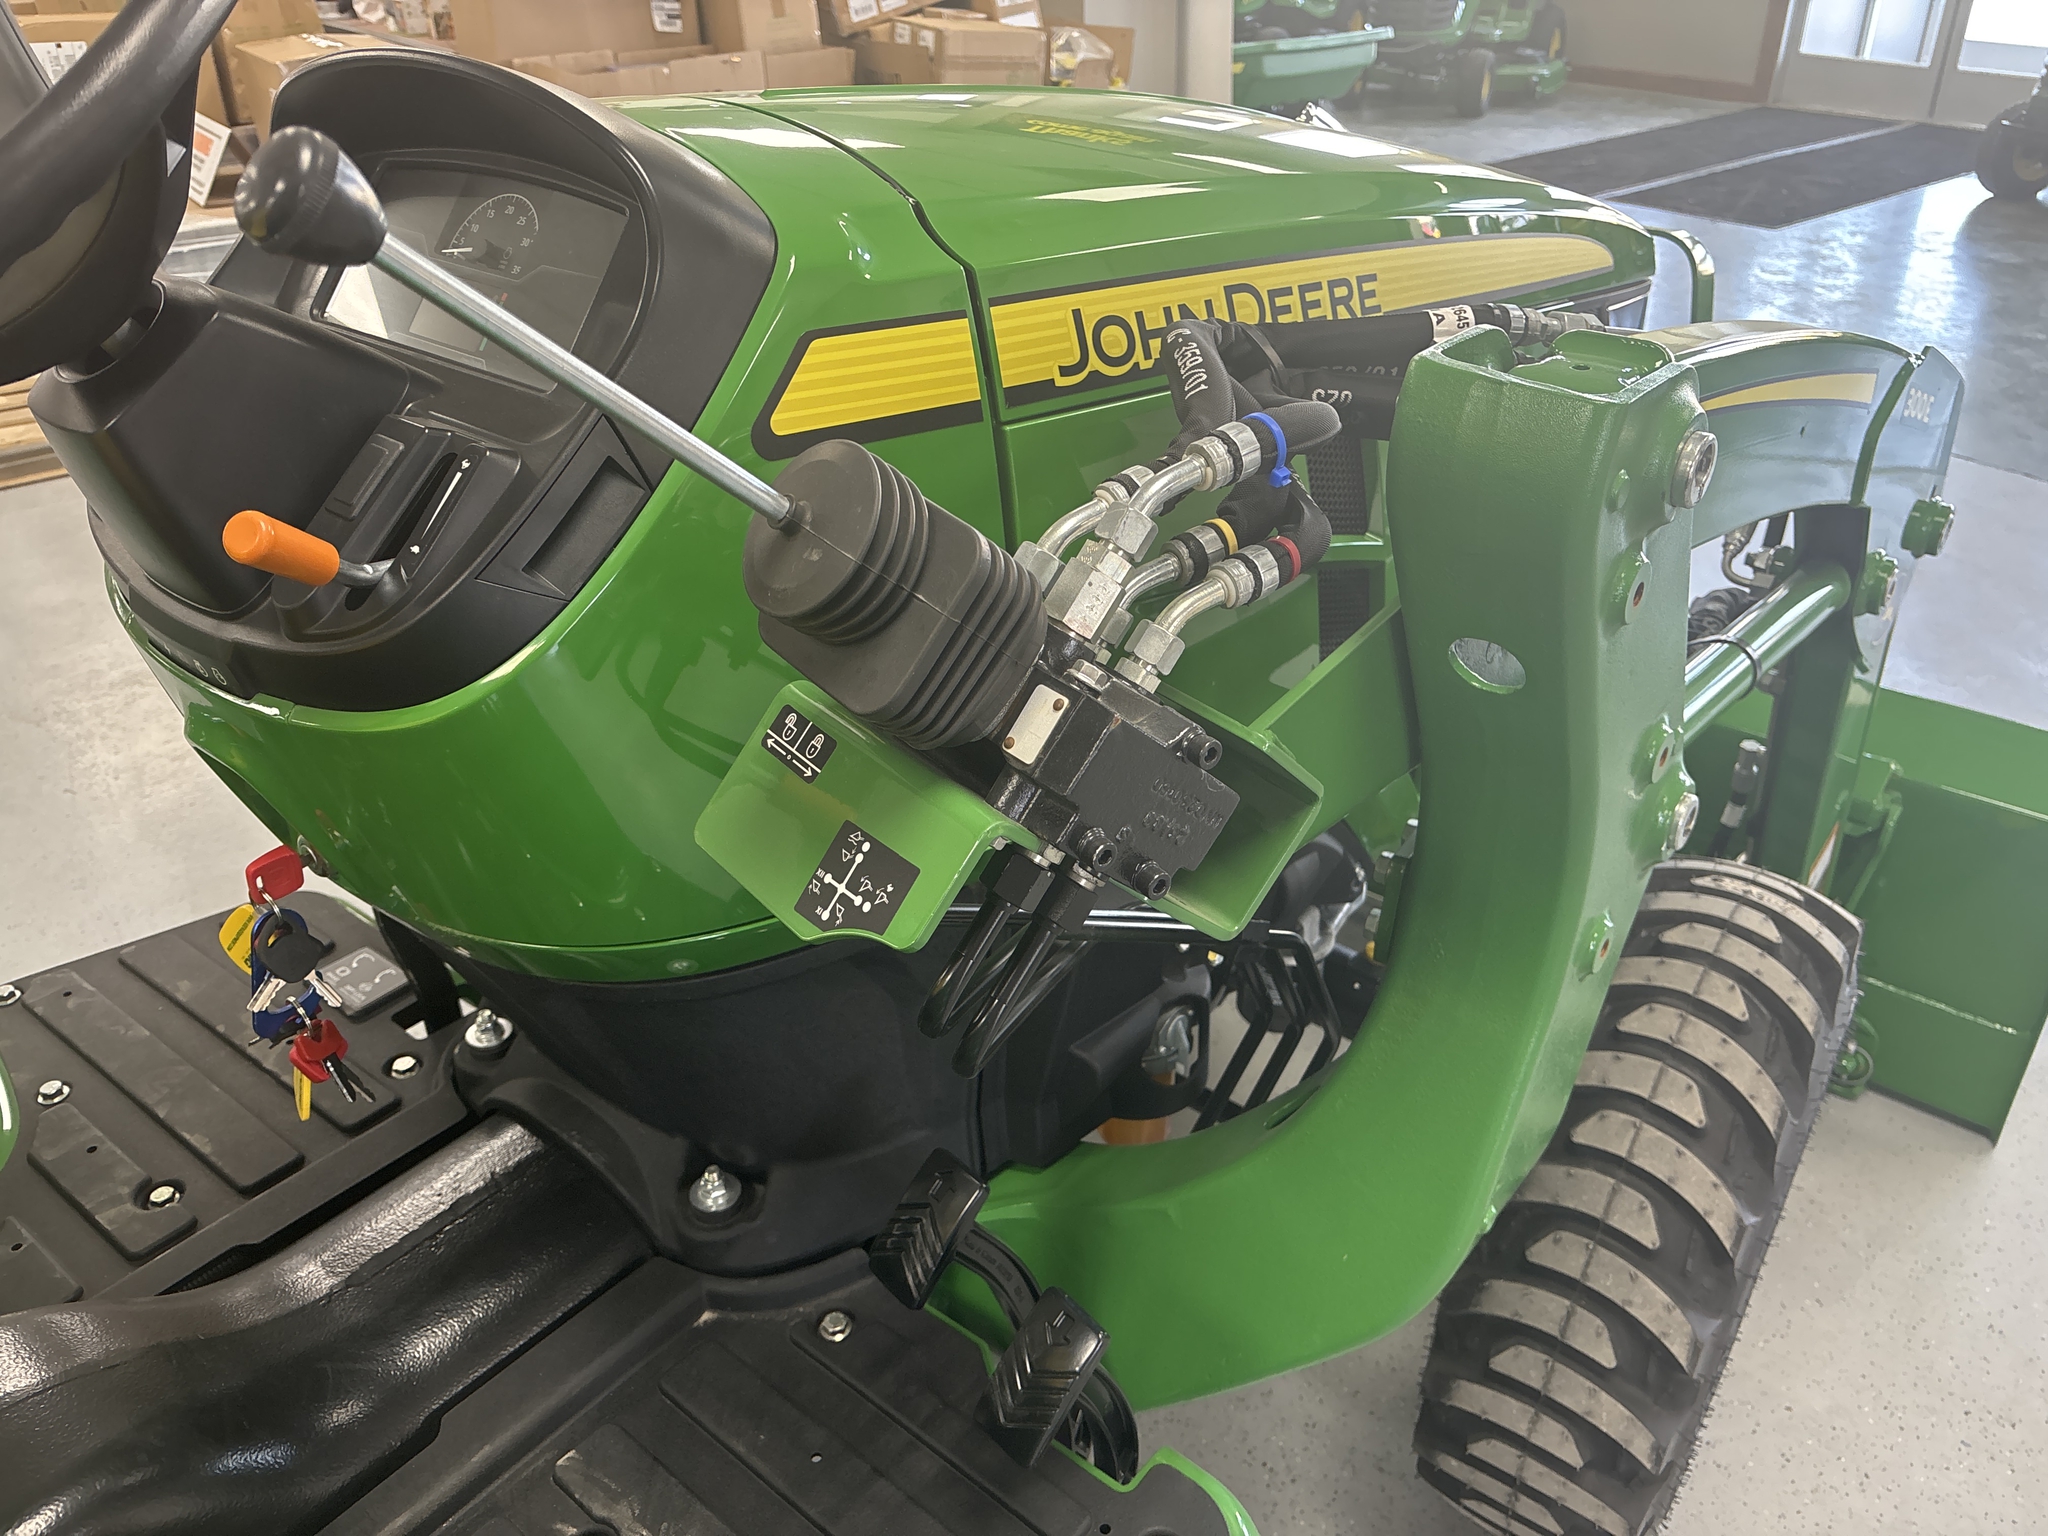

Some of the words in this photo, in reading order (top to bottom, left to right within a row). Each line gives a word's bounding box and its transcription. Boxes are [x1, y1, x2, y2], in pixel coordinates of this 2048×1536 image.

[486, 209, 495, 218] 15
[504, 205, 515, 215] 20
[516, 216, 527, 226] 25
[470, 223, 479, 233] 10
[520, 237, 530, 247] 30
[511, 265, 521, 275] 35
[1223, 273, 1382, 324] DEERE
[1432, 312, 1446, 326] A
